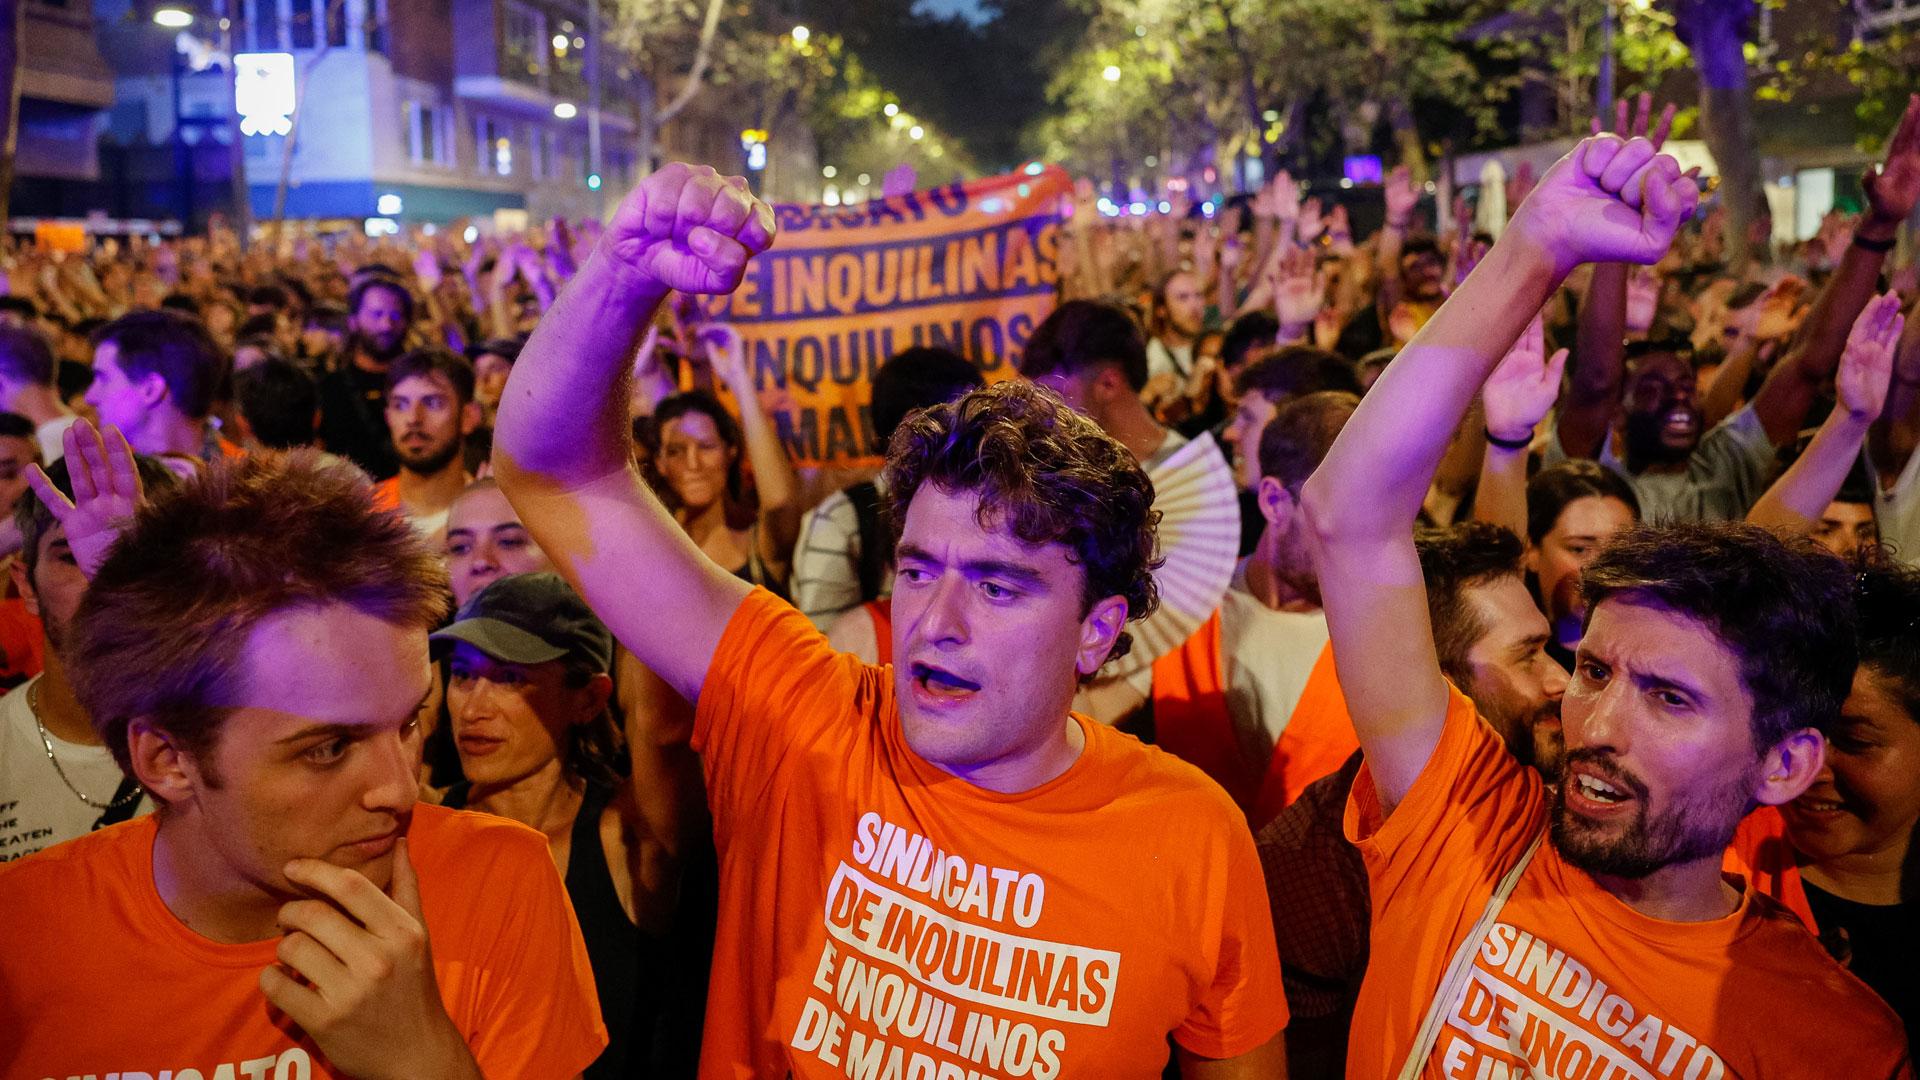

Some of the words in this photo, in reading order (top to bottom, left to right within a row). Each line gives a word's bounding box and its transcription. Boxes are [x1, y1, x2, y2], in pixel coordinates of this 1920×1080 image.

[771, 225, 1059, 315] INQUILINAS
[0, 827, 53, 847] EATEN
[853, 812, 1045, 928] SINDICATO
[828, 874, 883, 941] DE
[878, 903, 1110, 1015] INQUILINAS
[791, 996, 846, 1067] DE
[813, 939, 838, 995] E
[837, 955, 1066, 1080] INQUILINOS
[1457, 977, 1519, 1040] DE
[1481, 922, 1725, 1080] SINDICATO
[1442, 1035, 1475, 1080] E
